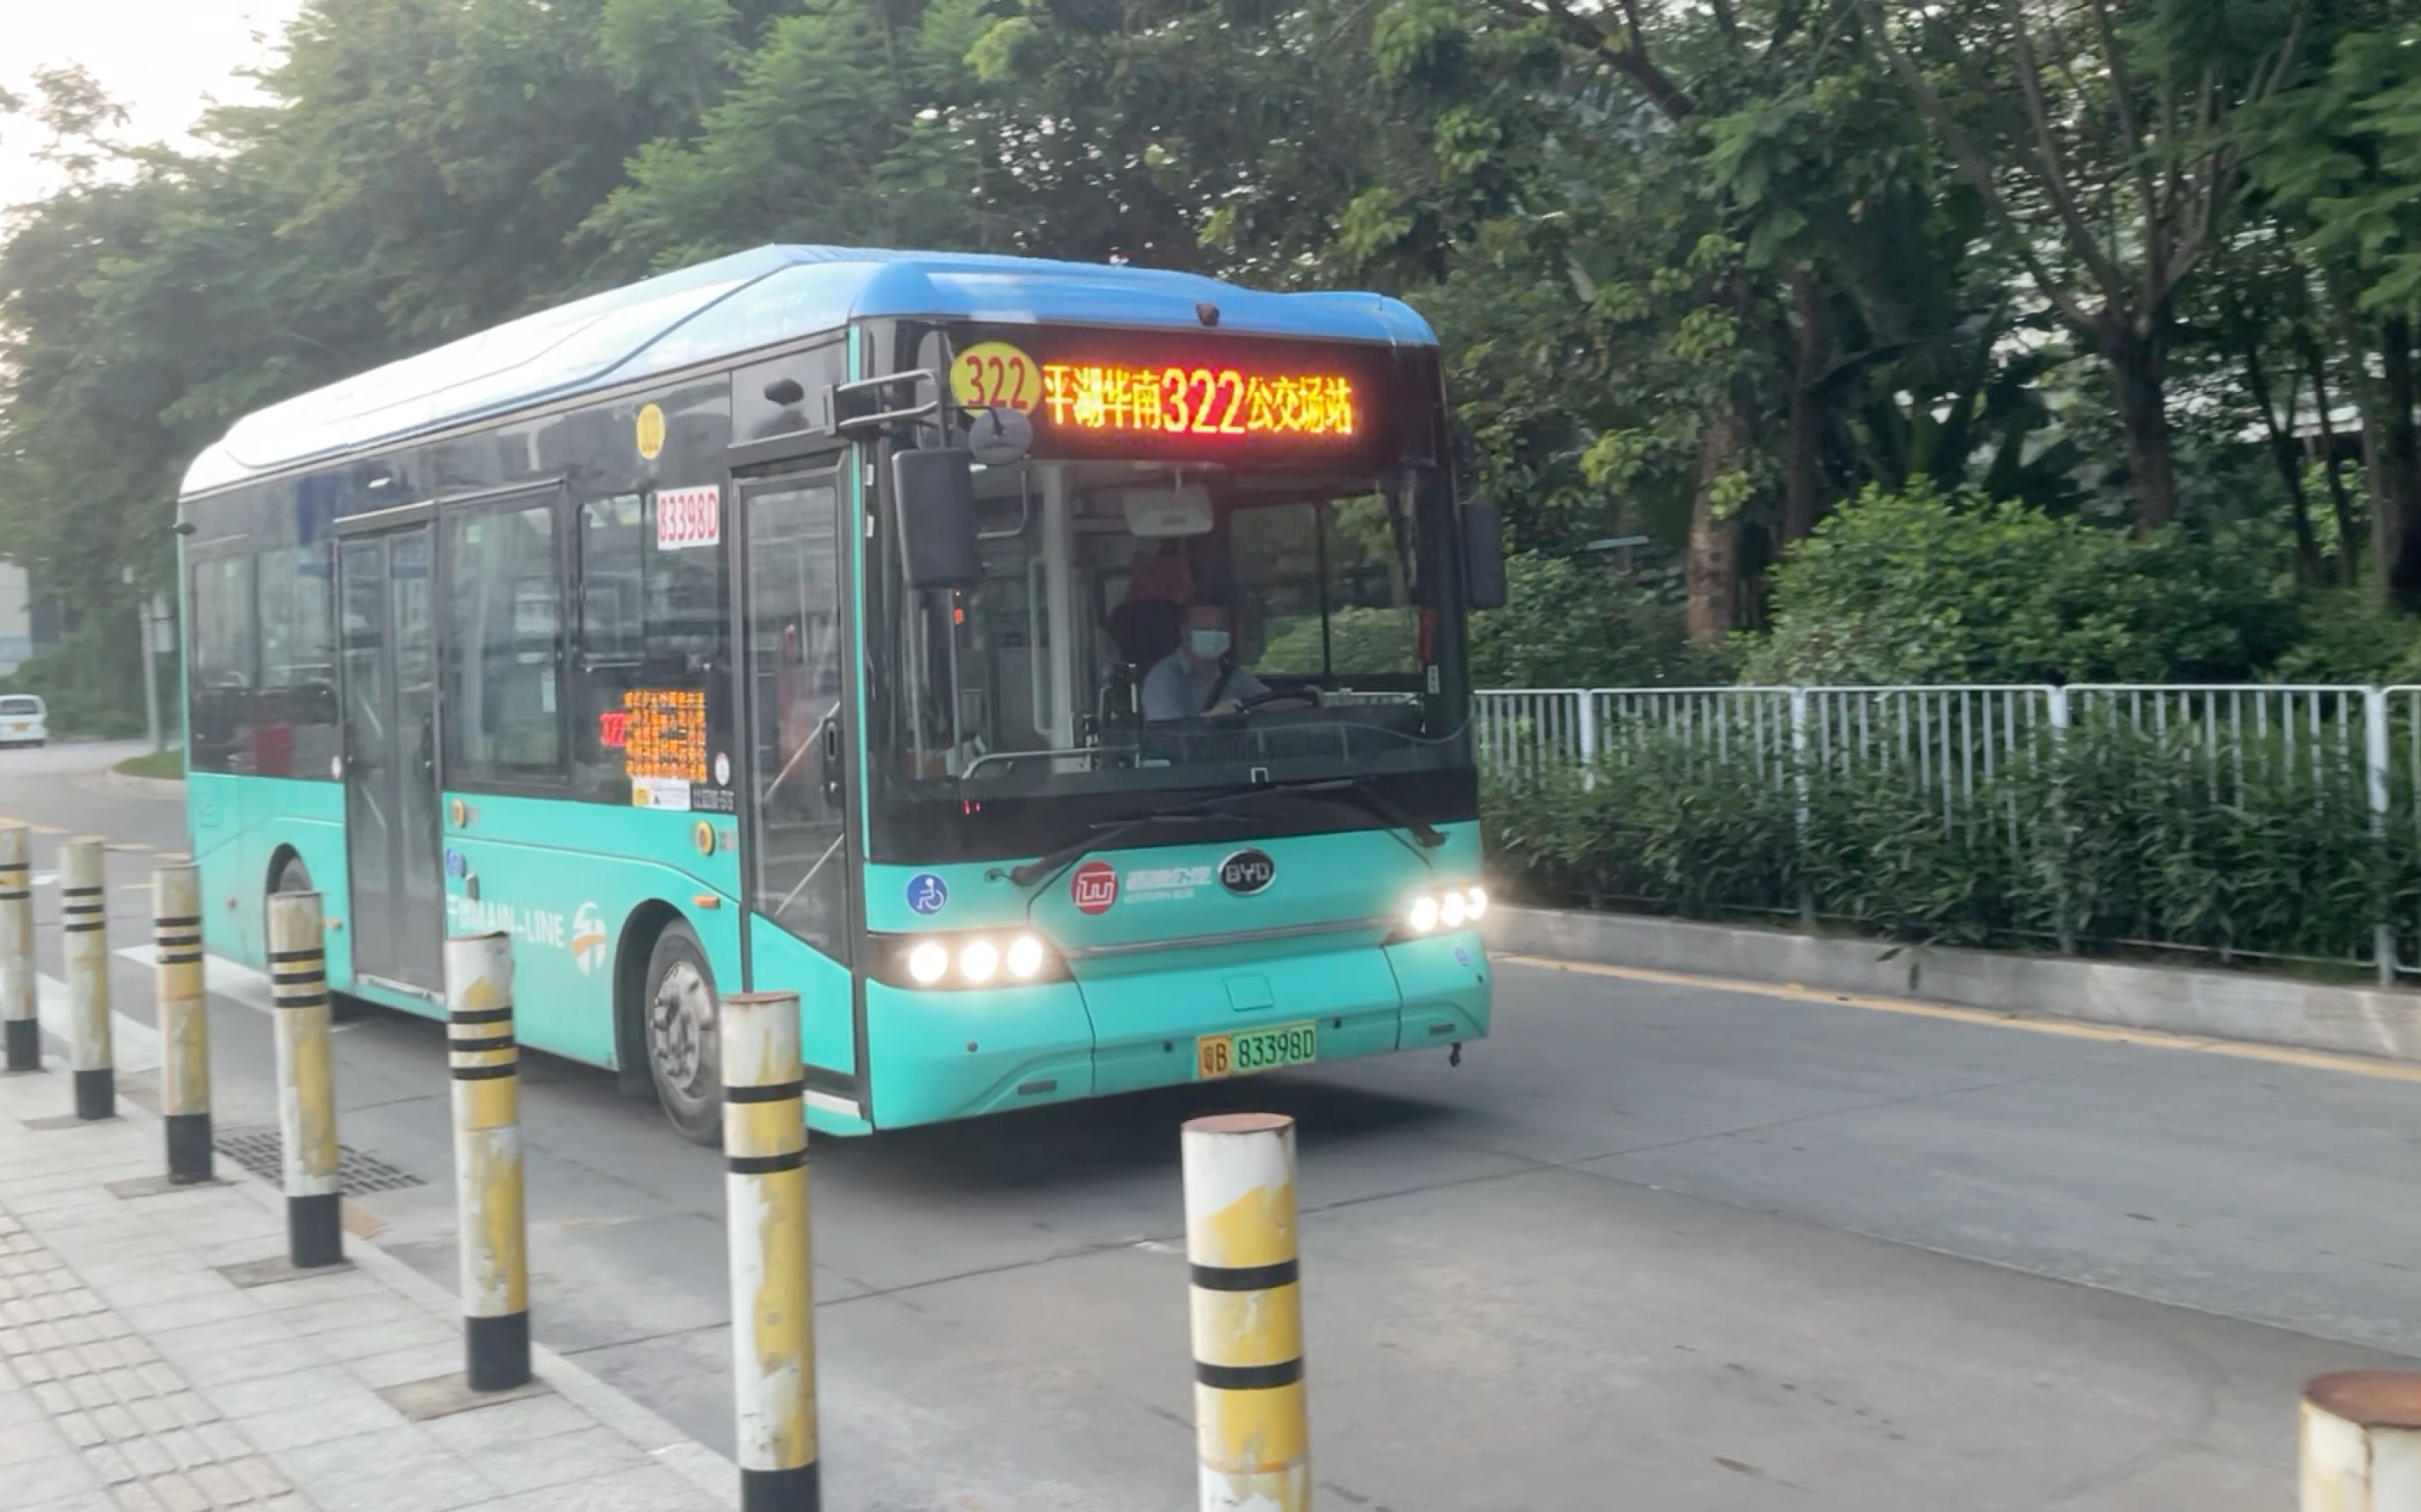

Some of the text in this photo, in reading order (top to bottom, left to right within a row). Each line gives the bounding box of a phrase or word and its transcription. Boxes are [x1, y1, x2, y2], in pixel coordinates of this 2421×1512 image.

[965, 355, 1027, 410] 322
[660, 492, 717, 541] 83398D
[1226, 863, 1270, 884] BYD
[1238, 1029, 1313, 1068] 83398D
